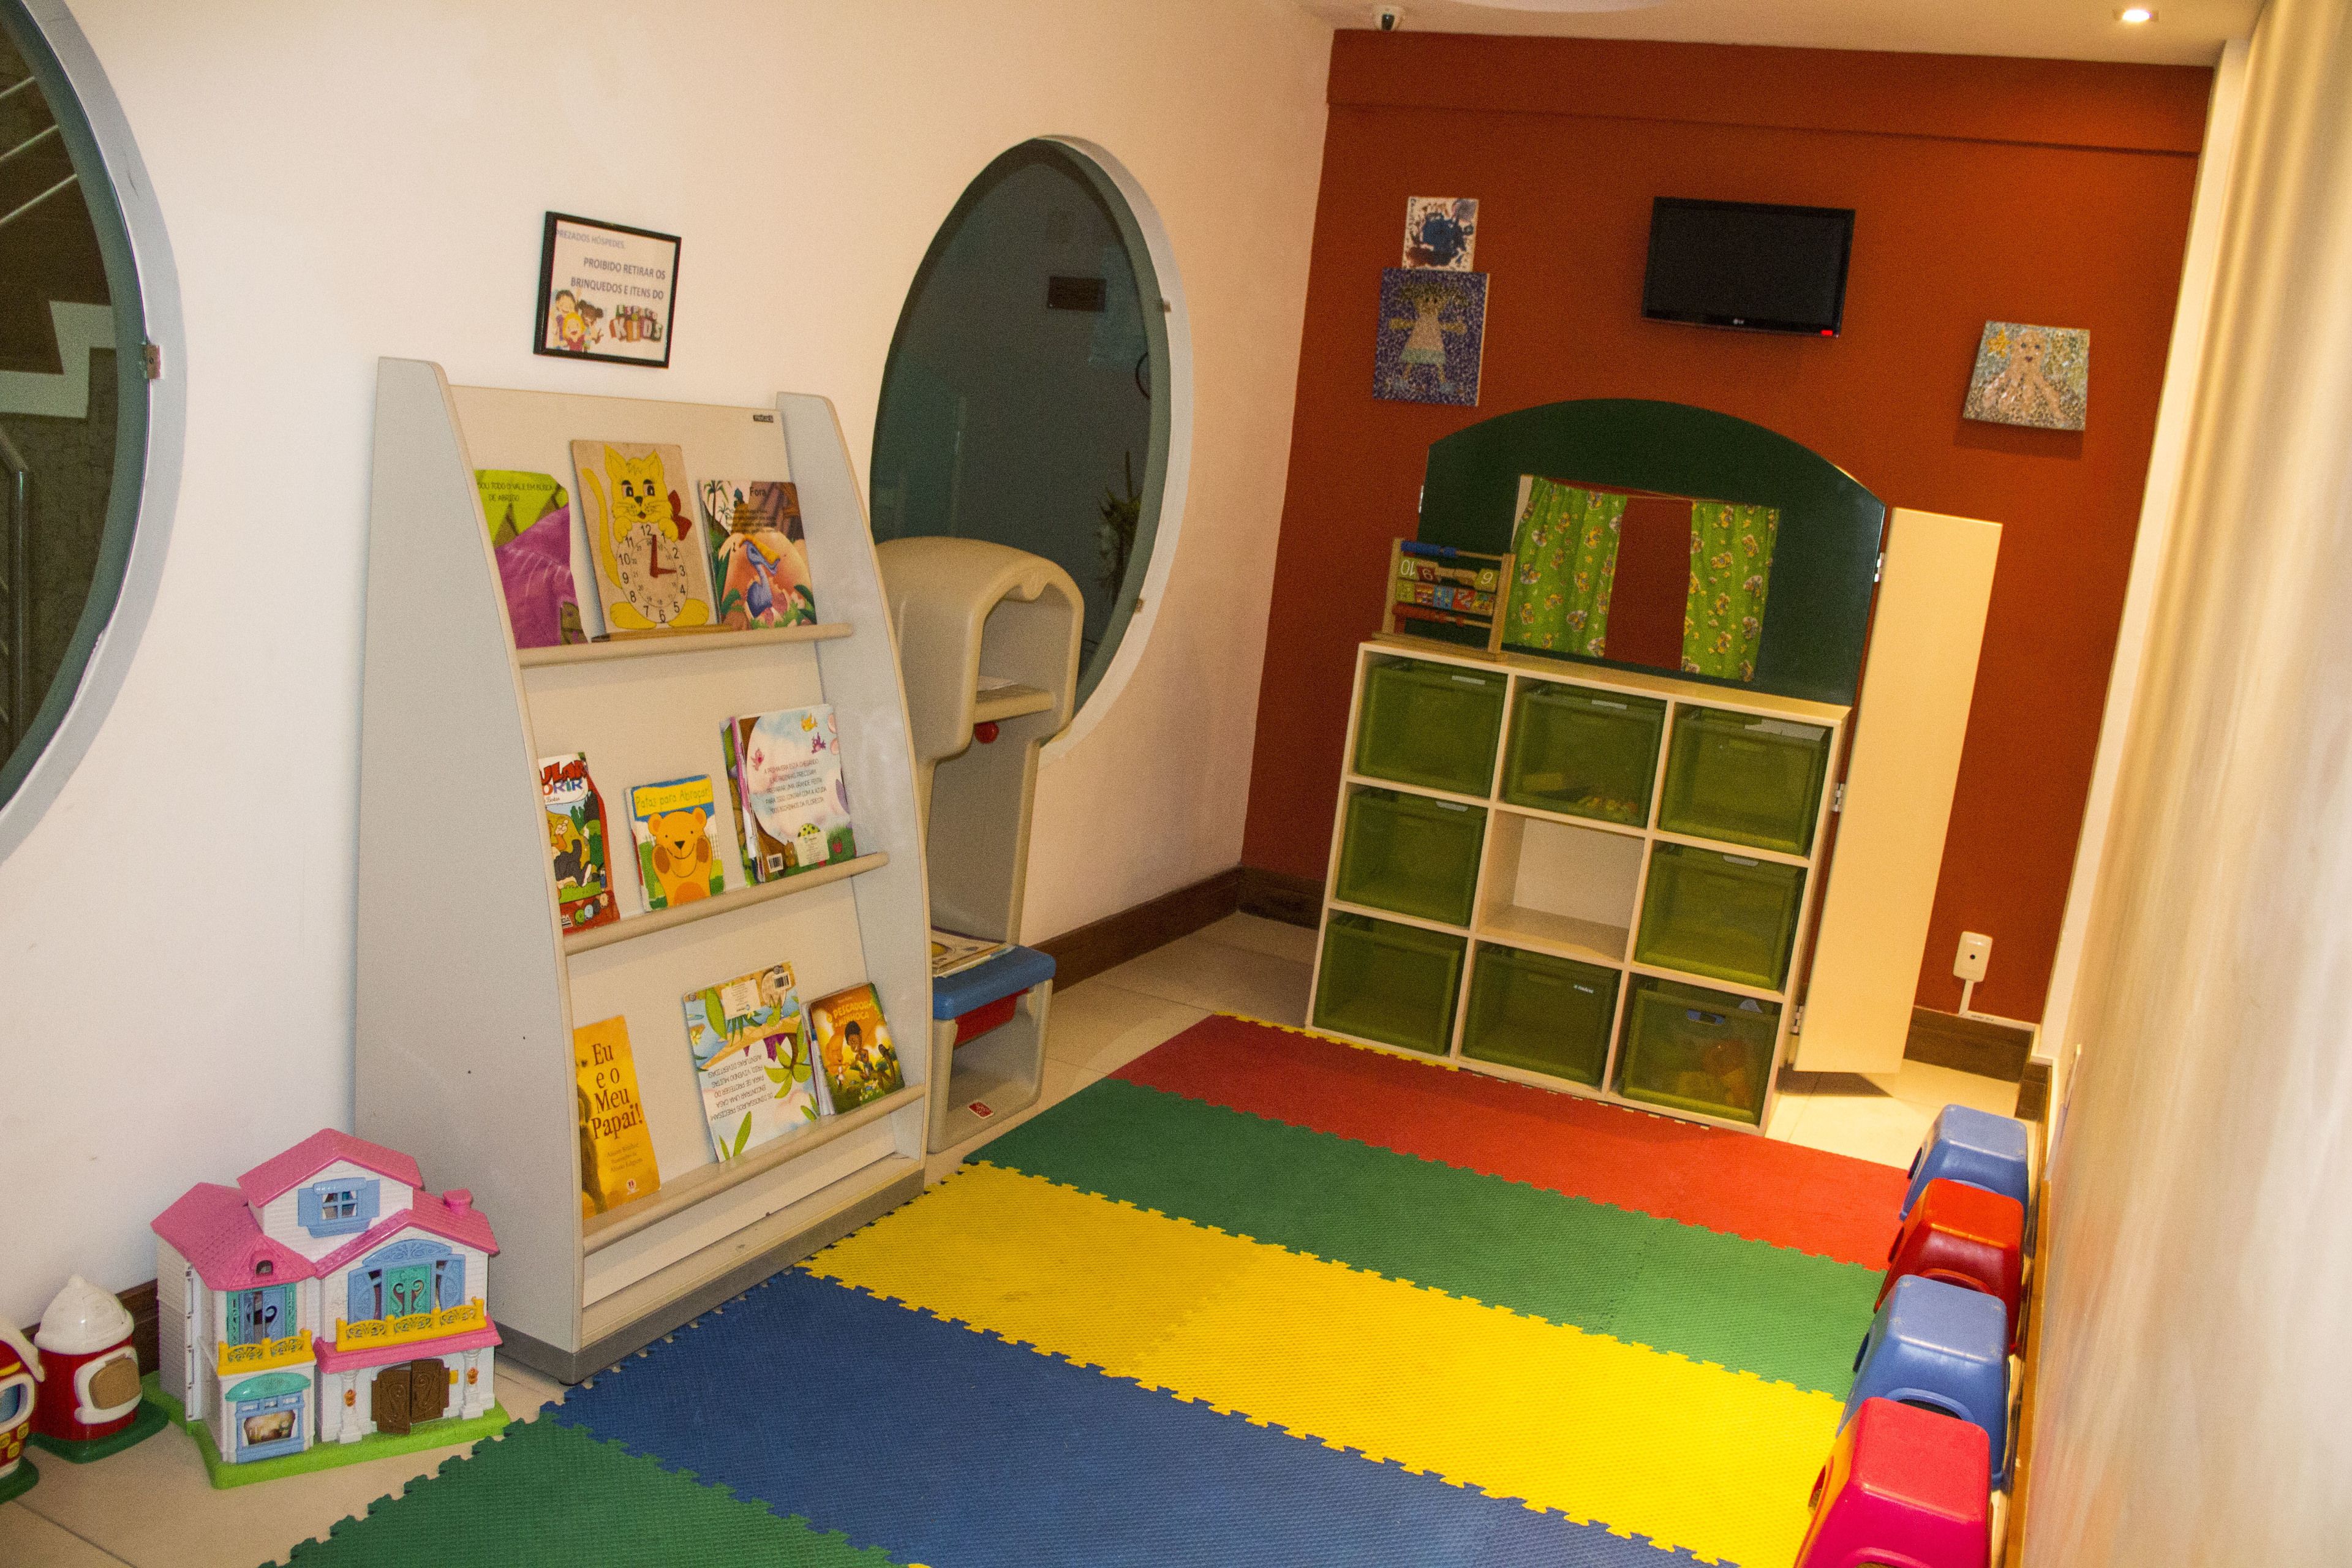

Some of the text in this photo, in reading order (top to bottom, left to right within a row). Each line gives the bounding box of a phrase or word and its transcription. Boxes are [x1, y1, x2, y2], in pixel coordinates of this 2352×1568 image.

[584, 257, 666, 280] PROIBIDO RETIRAR OS
[571, 277, 664, 300] BRINQUEDOS E ITENS DO
[609, 317, 663, 342] KIDS
[641, 524, 654, 536] 12
[625, 537, 634, 548] 11
[662, 532, 666, 543] 1
[619, 553, 630, 566] 10
[672, 547, 679, 559] 2
[679, 565, 685, 576] 3
[622, 572, 629, 584] 9
[680, 584, 685, 595] 4
[630, 590, 636, 603] 8
[643, 605, 649, 617] 7
[674, 601, 680, 613] 5
[659, 609, 666, 623] 6
[660, 794, 676, 805] para
[826, 1013, 833, 1023] O
[839, 1011, 869, 1027] MINHOCA
[592, 1043, 614, 1066] Eu
[737, 1054, 763, 1068] AVENTURAS
[596, 1068, 620, 1088] e o
[729, 1069, 750, 1081] VIVENDO
[752, 1075, 764, 1084] PARA
[711, 1076, 730, 1088] MUITAS
[722, 1082, 745, 1095] PROTEGER
[594, 1088, 630, 1114] Meu
[715, 1084, 766, 1108] ENCONTRAR UMA CASA
[736, 1095, 767, 1111] DINOSSAUROS
[710, 1107, 736, 1121] PRECISAM
[591, 1103, 643, 1140] Papai!
